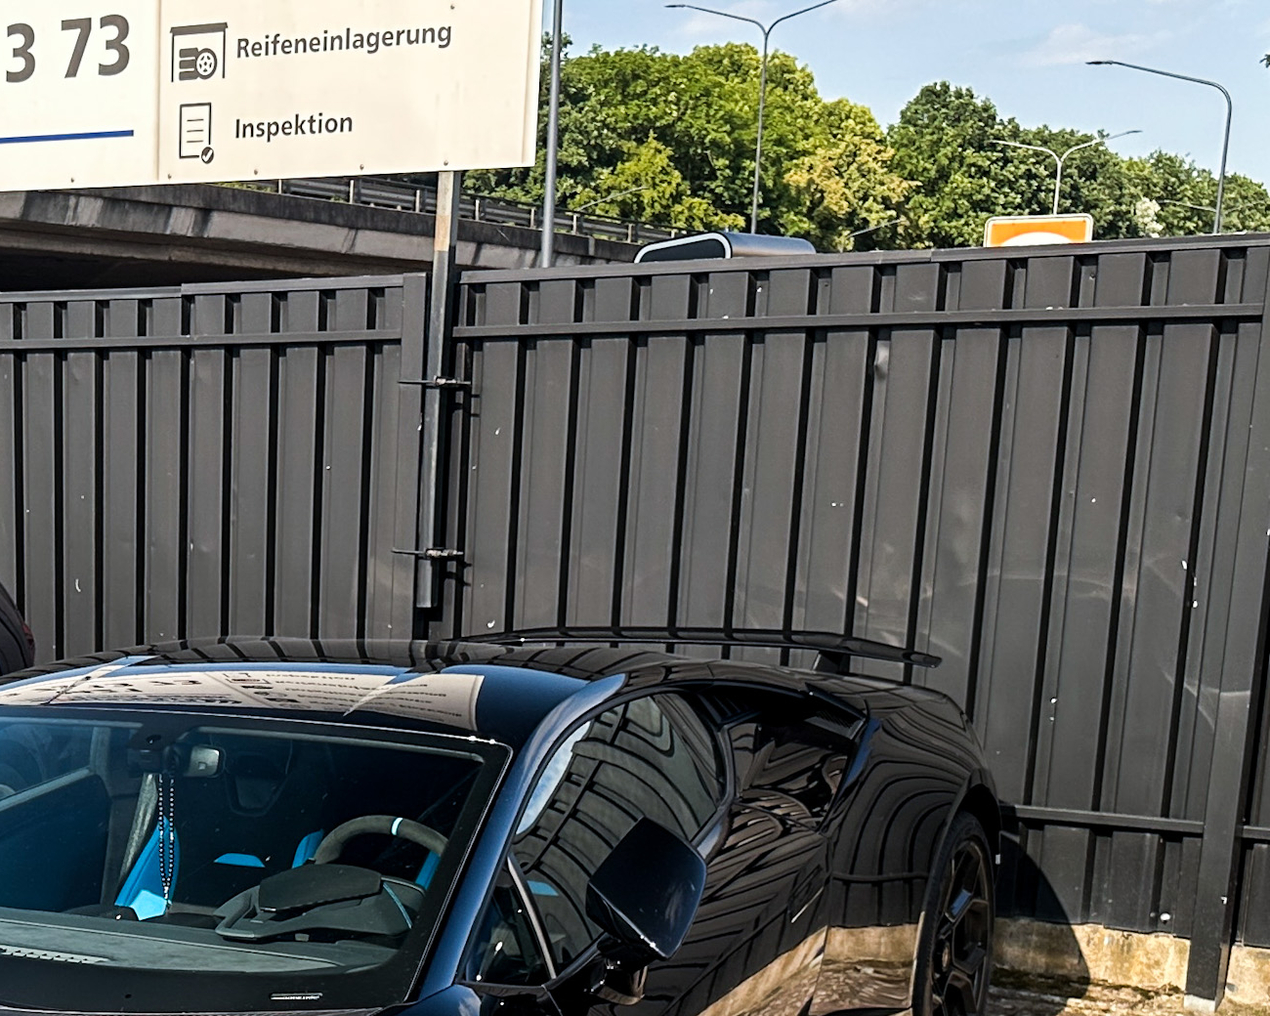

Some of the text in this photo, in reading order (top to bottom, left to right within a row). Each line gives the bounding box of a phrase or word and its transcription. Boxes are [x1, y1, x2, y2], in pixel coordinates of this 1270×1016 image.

[61, 14, 130, 79] 73
[236, 25, 452, 59] Reifeneinlagerung
[235, 112, 353, 143] Inspektion
